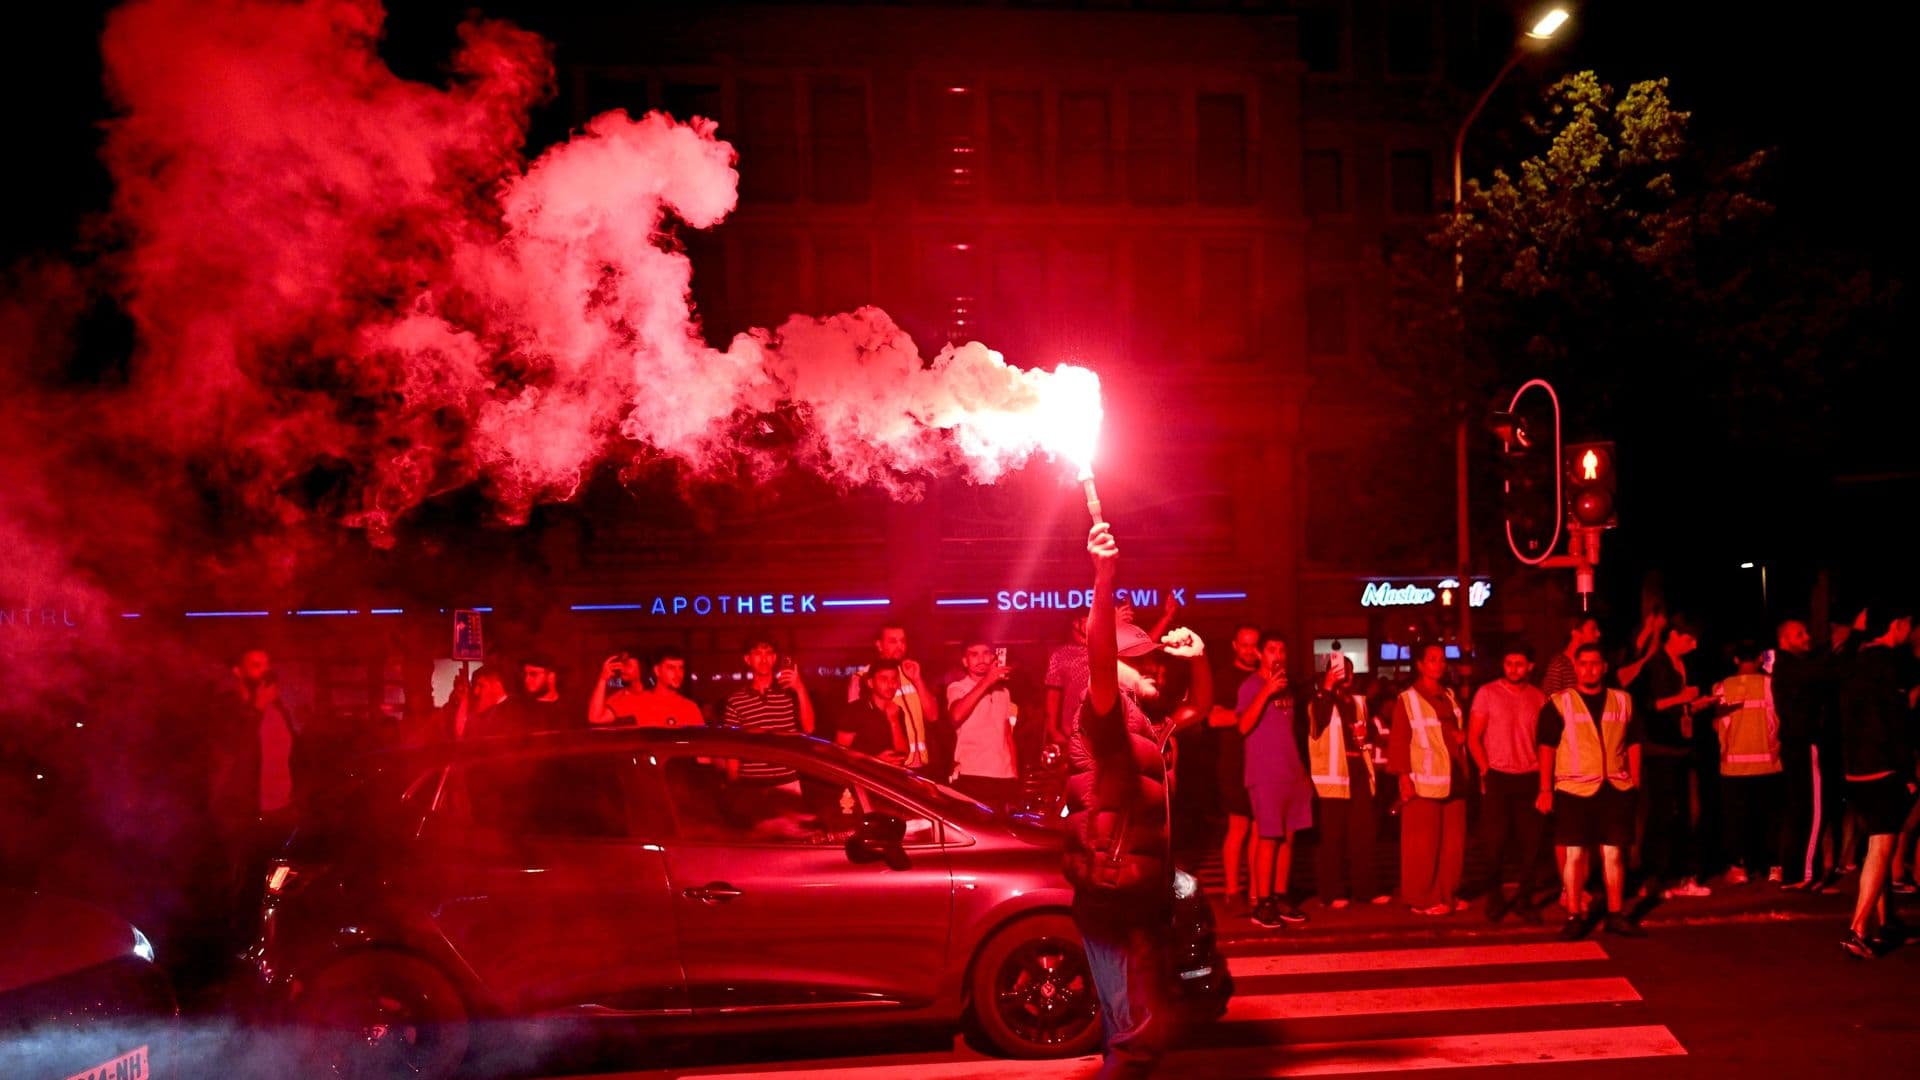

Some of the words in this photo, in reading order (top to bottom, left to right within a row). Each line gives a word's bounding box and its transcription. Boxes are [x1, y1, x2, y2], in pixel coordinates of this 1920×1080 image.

[651, 594, 816, 615] APOTHEEK
[996, 588, 1185, 610] SCHILDESWIK
[1361, 582, 1435, 606] Master
